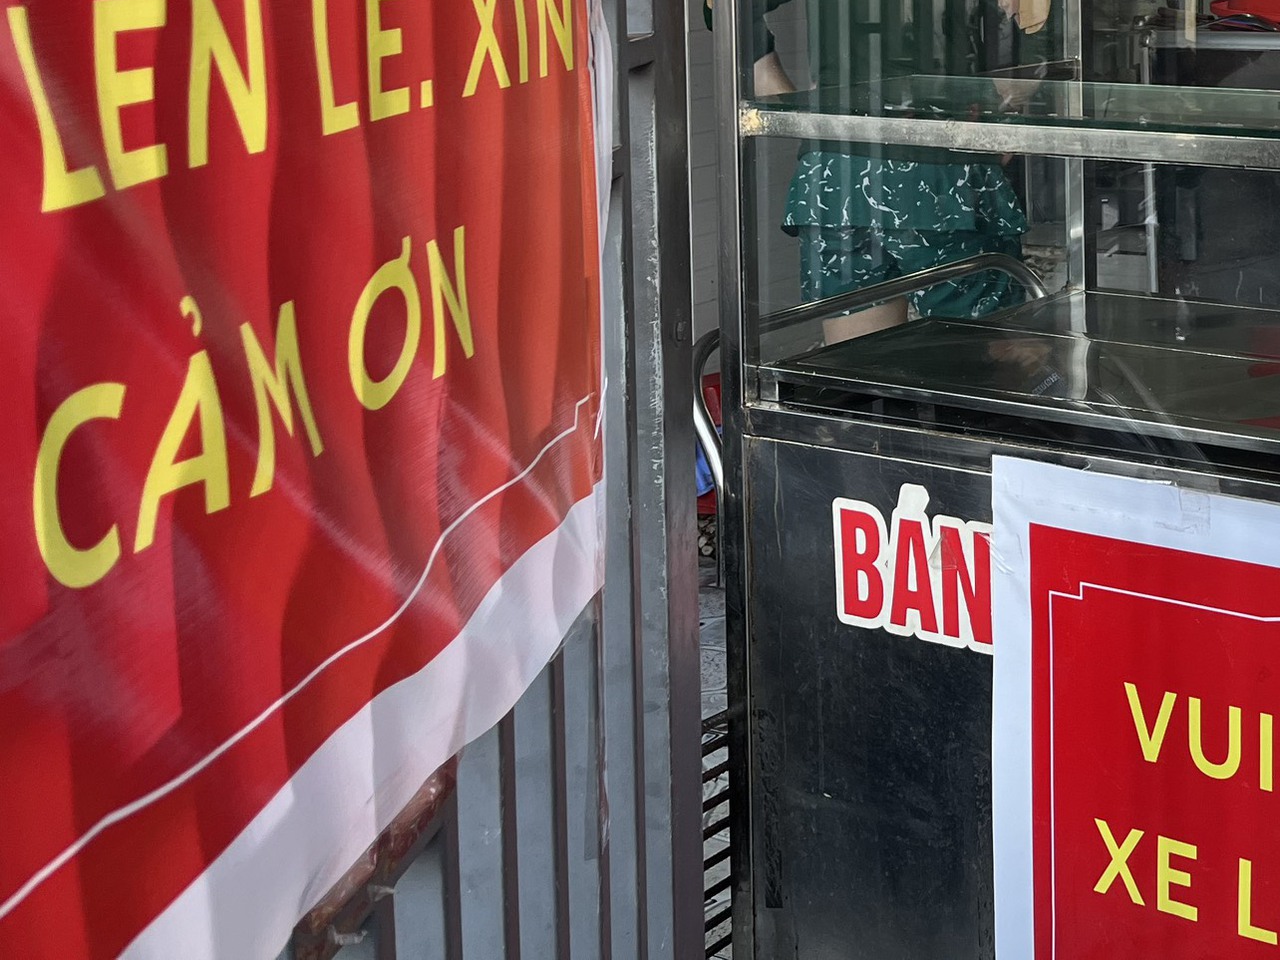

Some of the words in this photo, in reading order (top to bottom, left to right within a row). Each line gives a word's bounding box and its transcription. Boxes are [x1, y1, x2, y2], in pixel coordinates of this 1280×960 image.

[33, 295, 324, 589] CẢM
[348, 226, 475, 411] ƠN
[1123, 681, 1274, 793] VUI
[1093, 818, 1199, 923] XE
